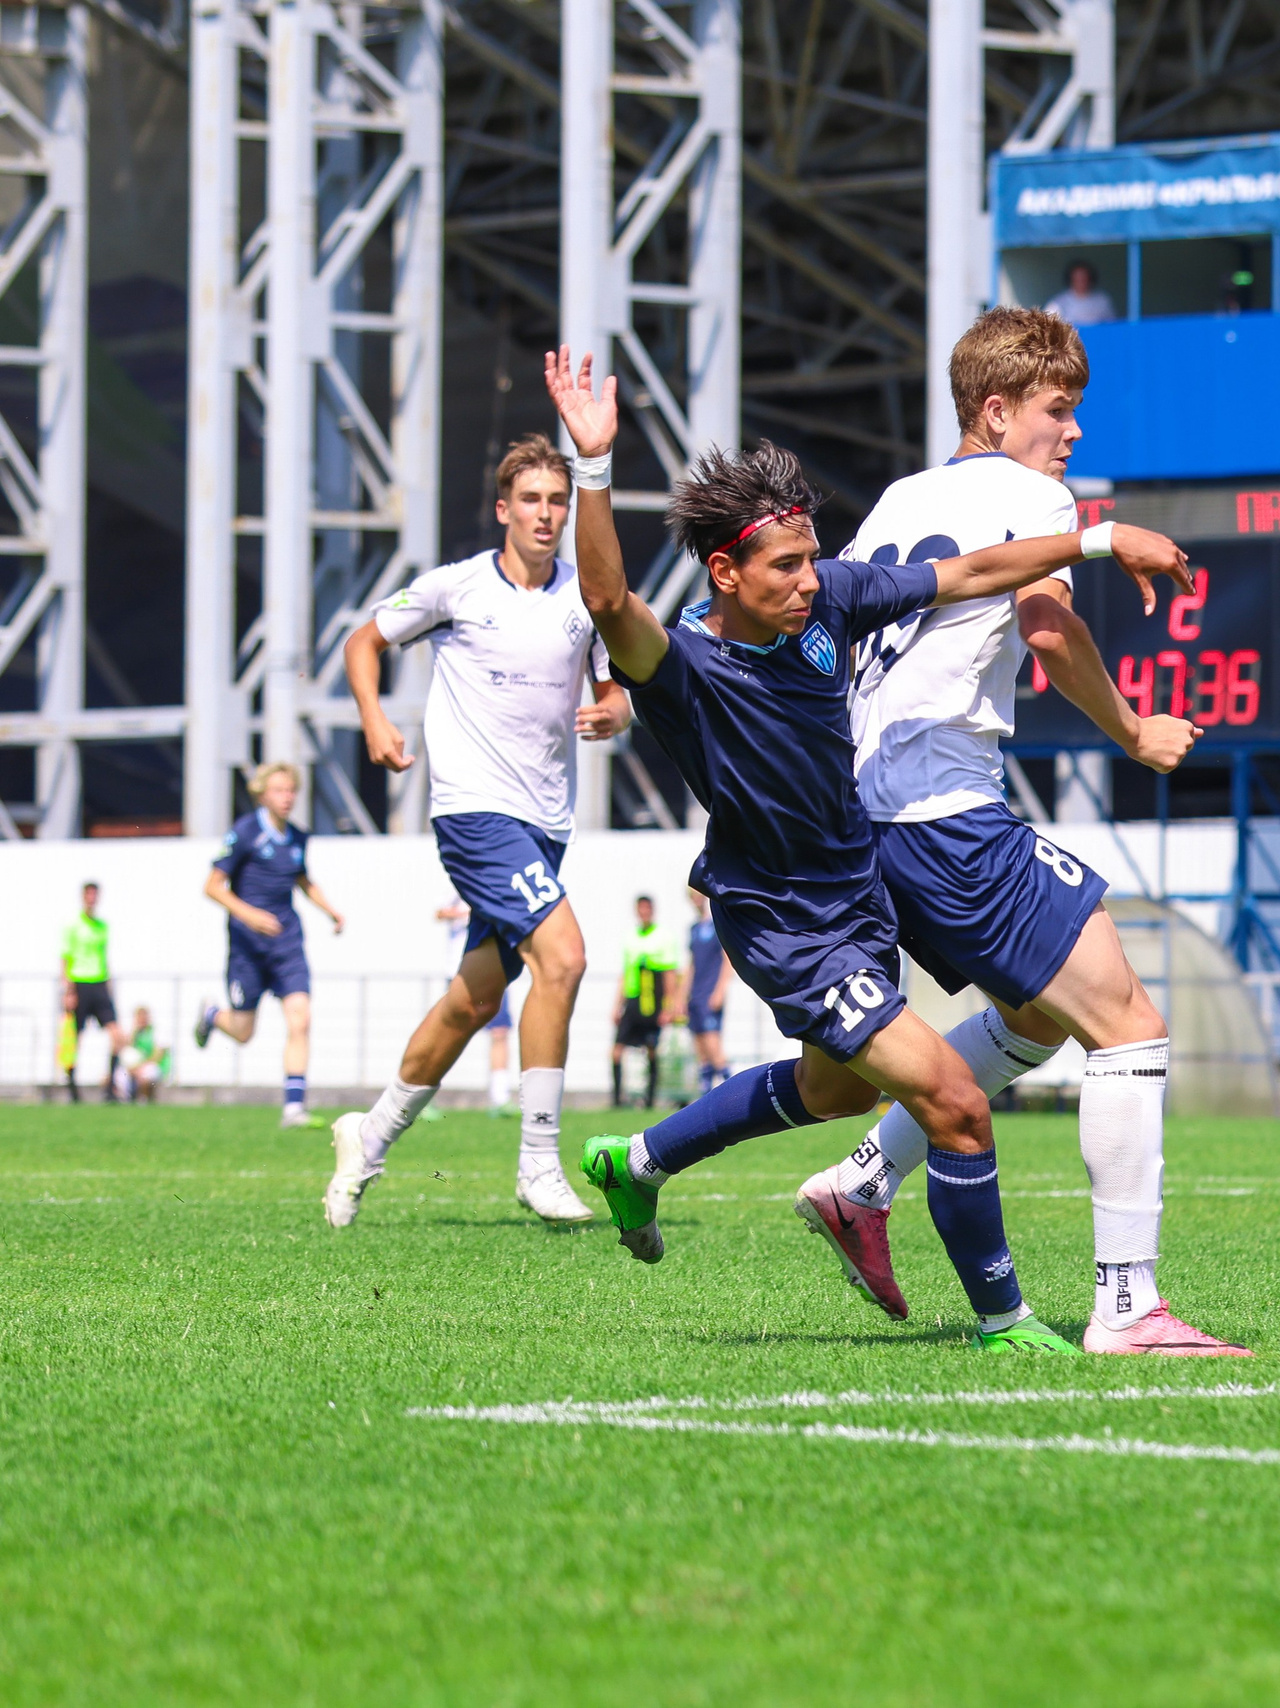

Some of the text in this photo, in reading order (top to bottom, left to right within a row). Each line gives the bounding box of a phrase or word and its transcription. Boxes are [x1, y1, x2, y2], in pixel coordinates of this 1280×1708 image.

[1168, 568, 1209, 641] 2
[510, 860, 560, 914] 13
[1034, 837, 1083, 887] 8
[823, 968, 885, 1033] 10
[1084, 1069, 1129, 1077] ELME
